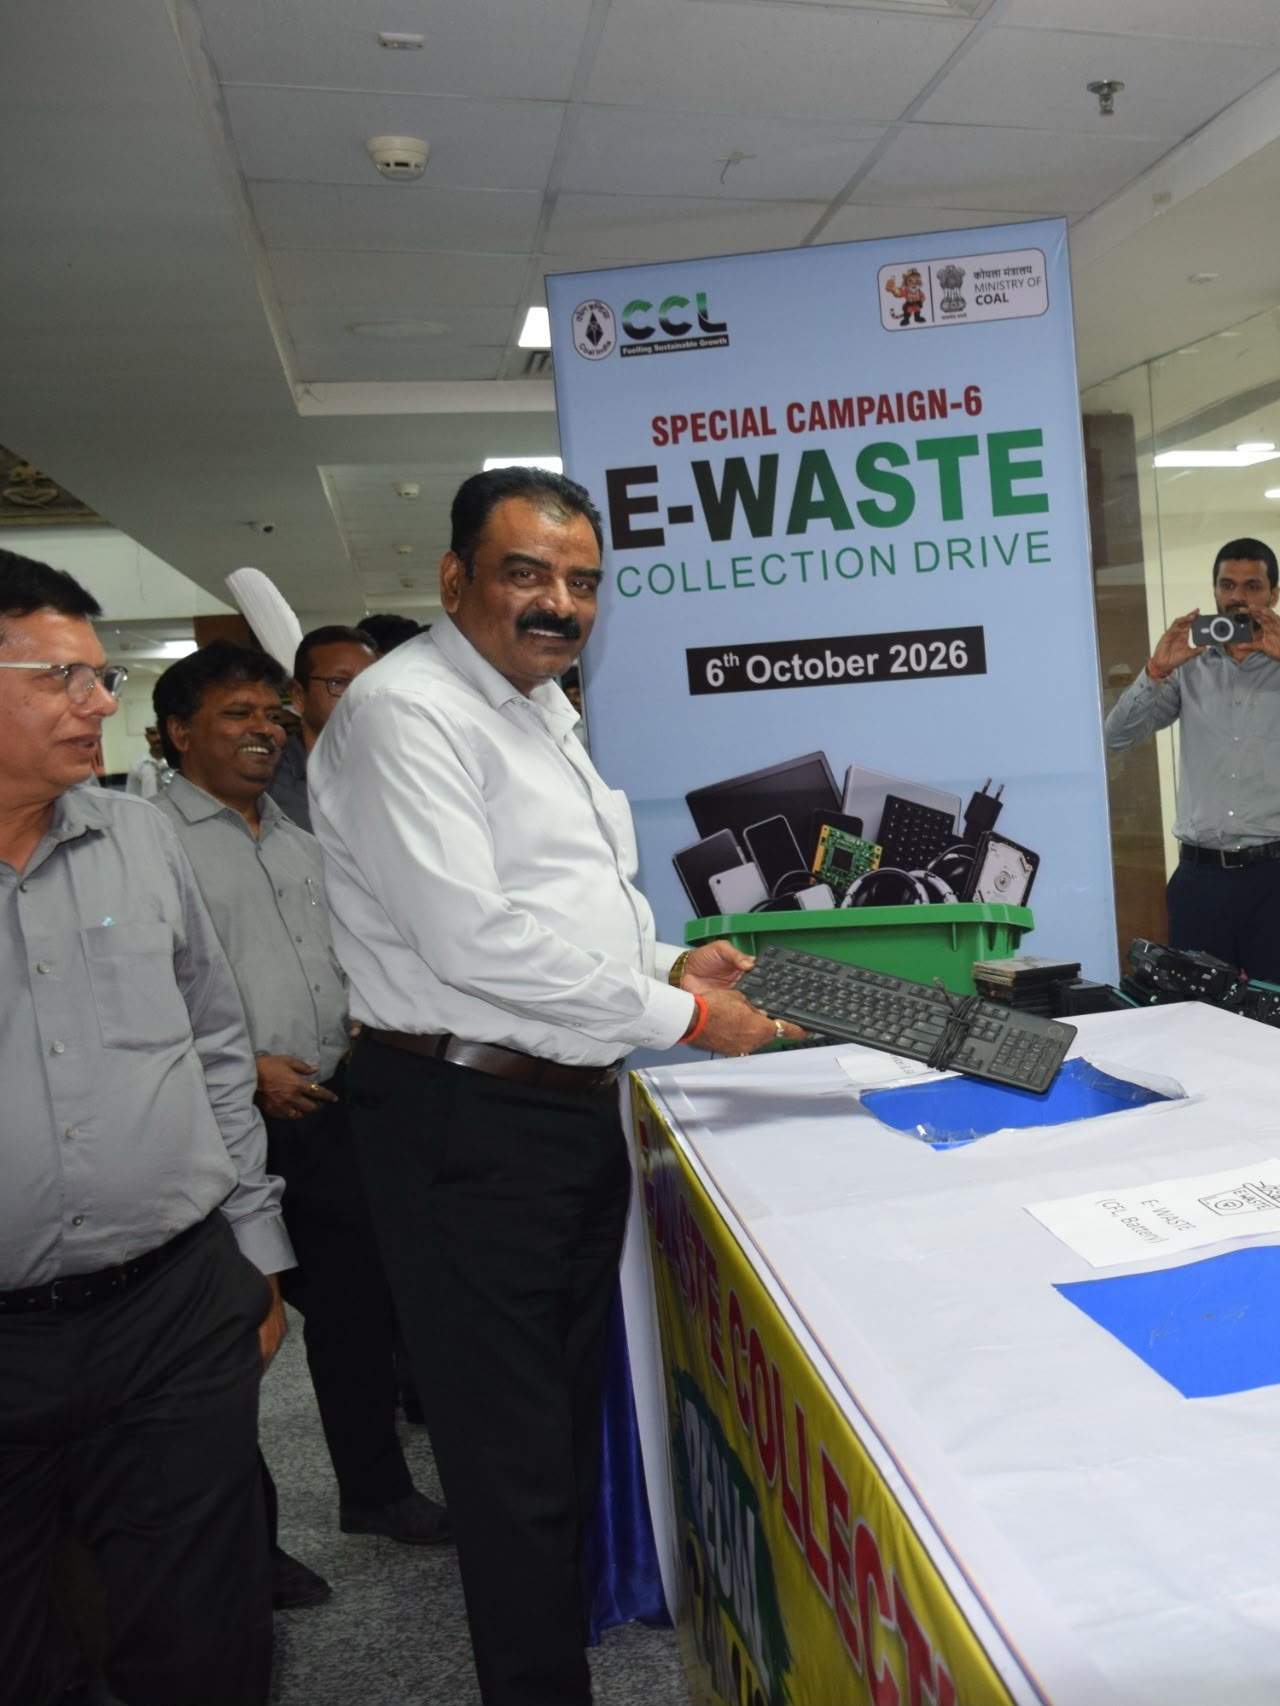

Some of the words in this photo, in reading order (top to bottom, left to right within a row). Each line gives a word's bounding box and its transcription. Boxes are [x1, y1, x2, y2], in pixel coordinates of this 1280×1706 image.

[974, 279, 1024, 293] MINISTRY
[1027, 276, 1042, 287] OF
[975, 293, 1009, 305] COAL
[622, 292, 727, 340] CCL
[700, 336, 728, 347] Growth
[652, 406, 776, 446] SPECIAL
[786, 384, 982, 433] CAMPAIGN-6
[605, 428, 1049, 550] E-WASTE
[616, 543, 897, 598] COLLECTION
[914, 531, 1051, 573] DRIVE
[706, 652, 739, 687] 6th
[745, 650, 880, 684] October
[890, 640, 968, 674] 2026
[729, 1286, 959, 1706] COLLECT
